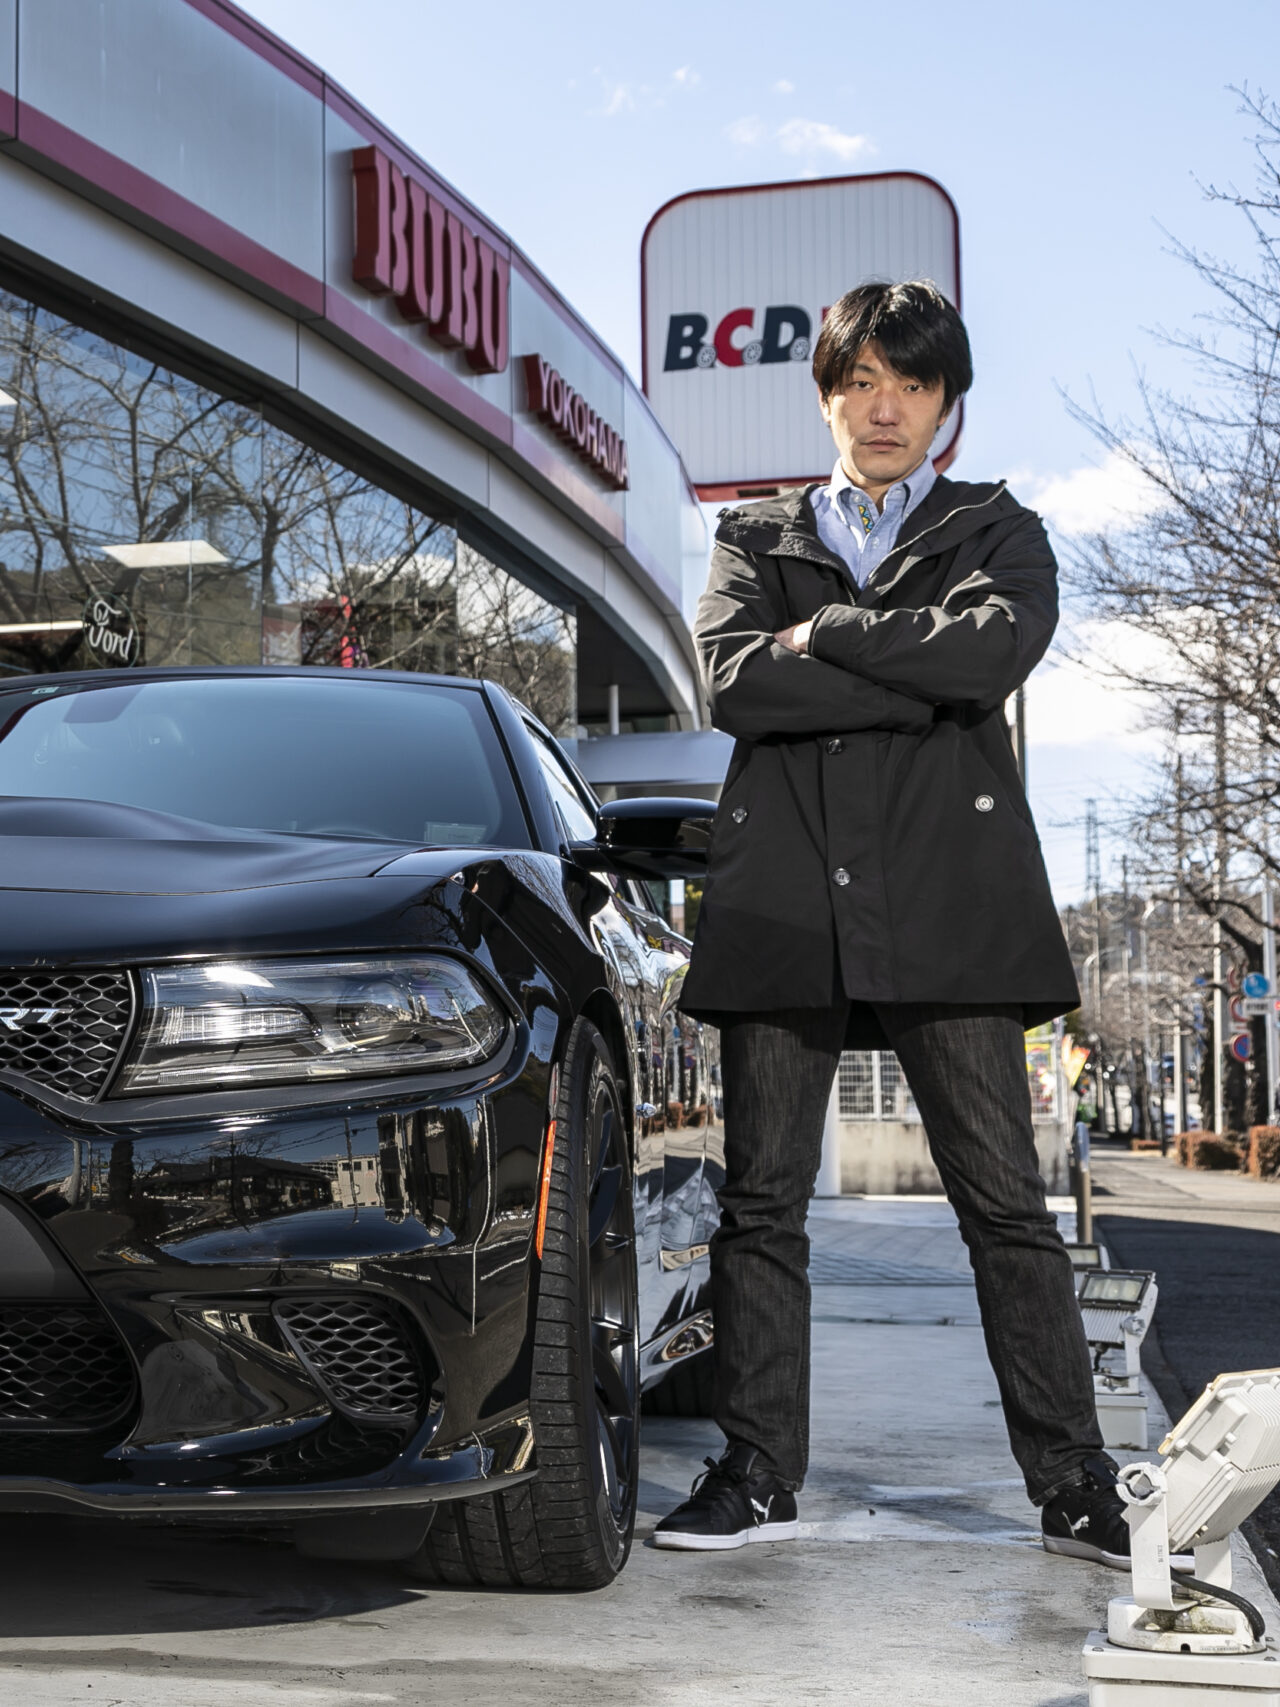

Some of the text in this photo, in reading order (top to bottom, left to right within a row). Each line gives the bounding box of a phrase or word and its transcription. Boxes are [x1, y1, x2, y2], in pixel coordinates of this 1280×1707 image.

[352, 145, 511, 375] BUBU
[523, 352, 629, 491] YOKOHAMA
[88, 599, 134, 661] Ford
